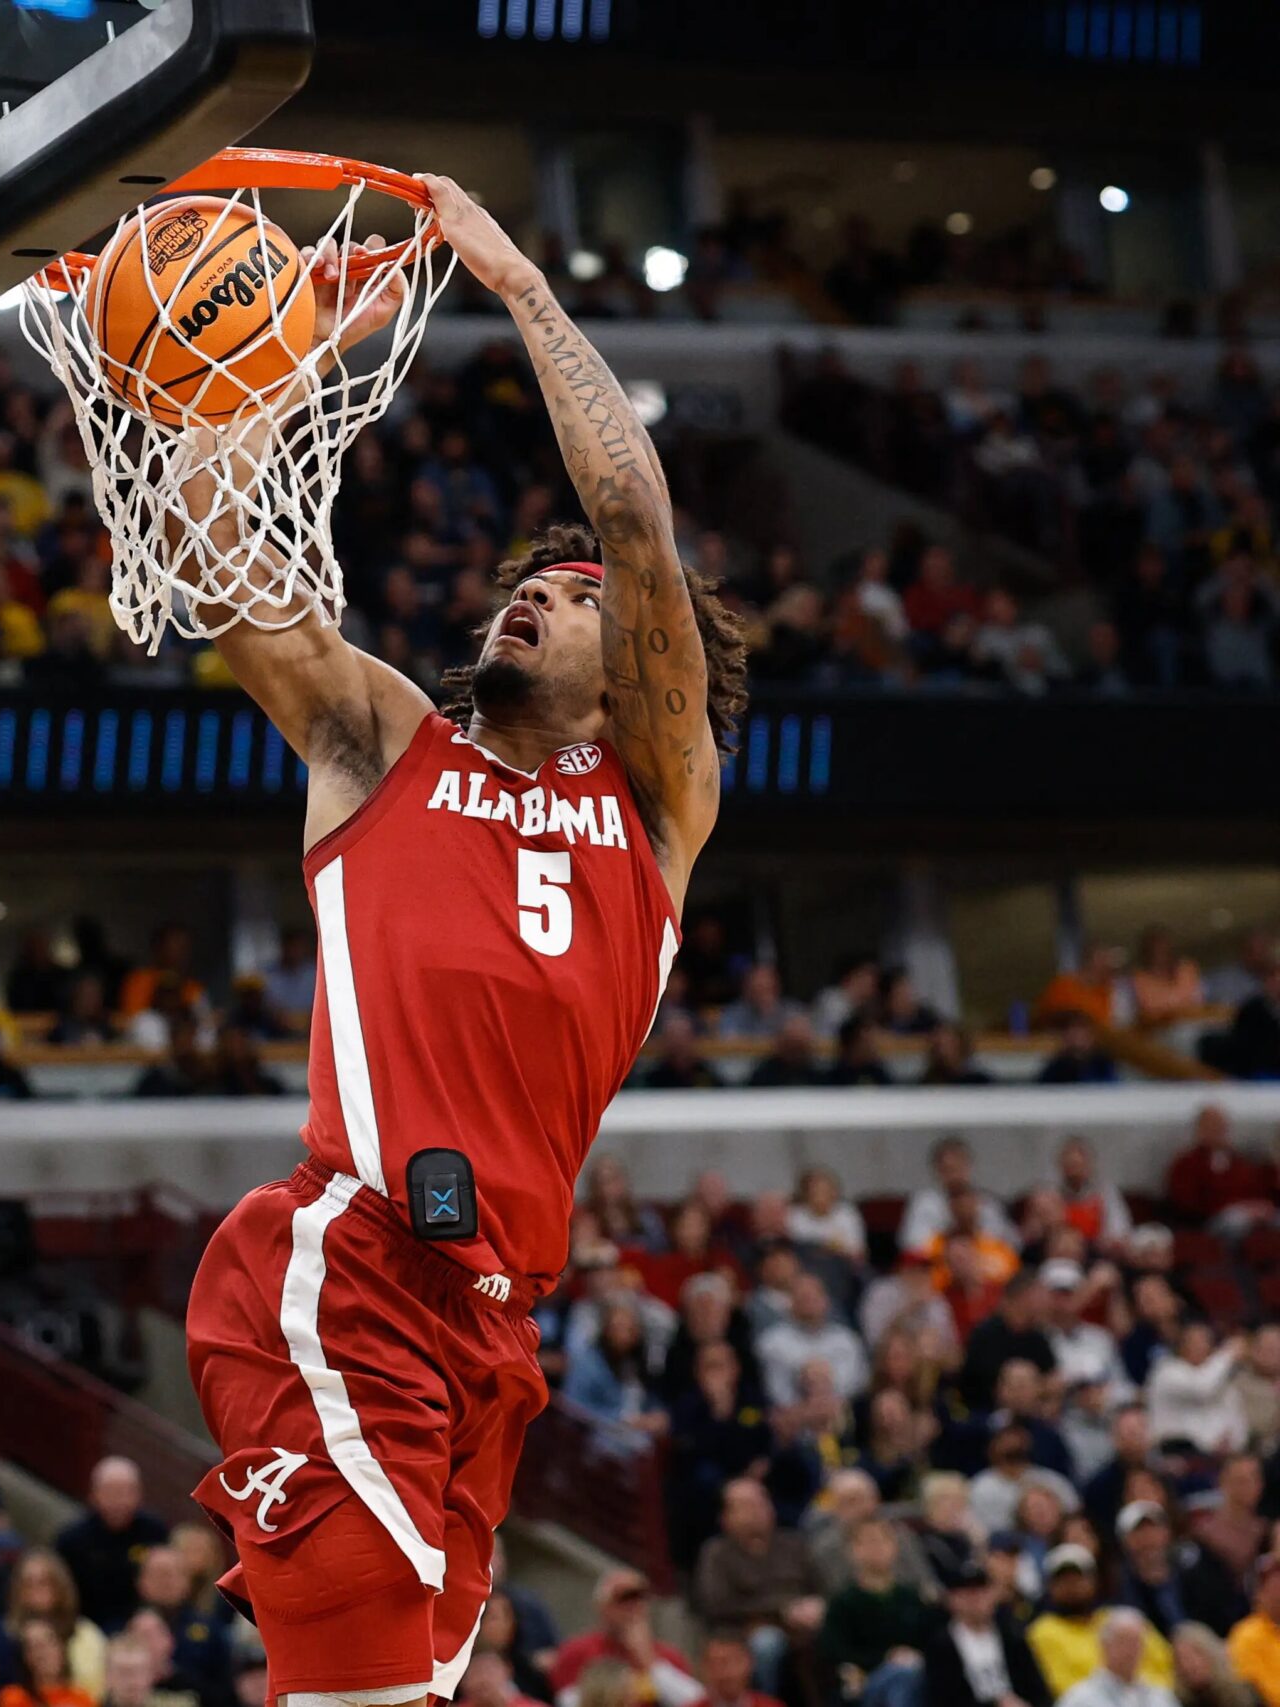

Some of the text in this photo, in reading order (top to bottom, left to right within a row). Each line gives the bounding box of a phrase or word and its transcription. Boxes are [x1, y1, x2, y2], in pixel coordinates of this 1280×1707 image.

[147, 220, 186, 262] MADNES
[162, 221, 199, 257] MARCH
[165, 238, 290, 348] Wilson
[199, 274, 218, 293] NXT
[557, 746, 598, 772] SEC
[426, 770, 629, 851] ALABAMA
[517, 847, 574, 957] 5
